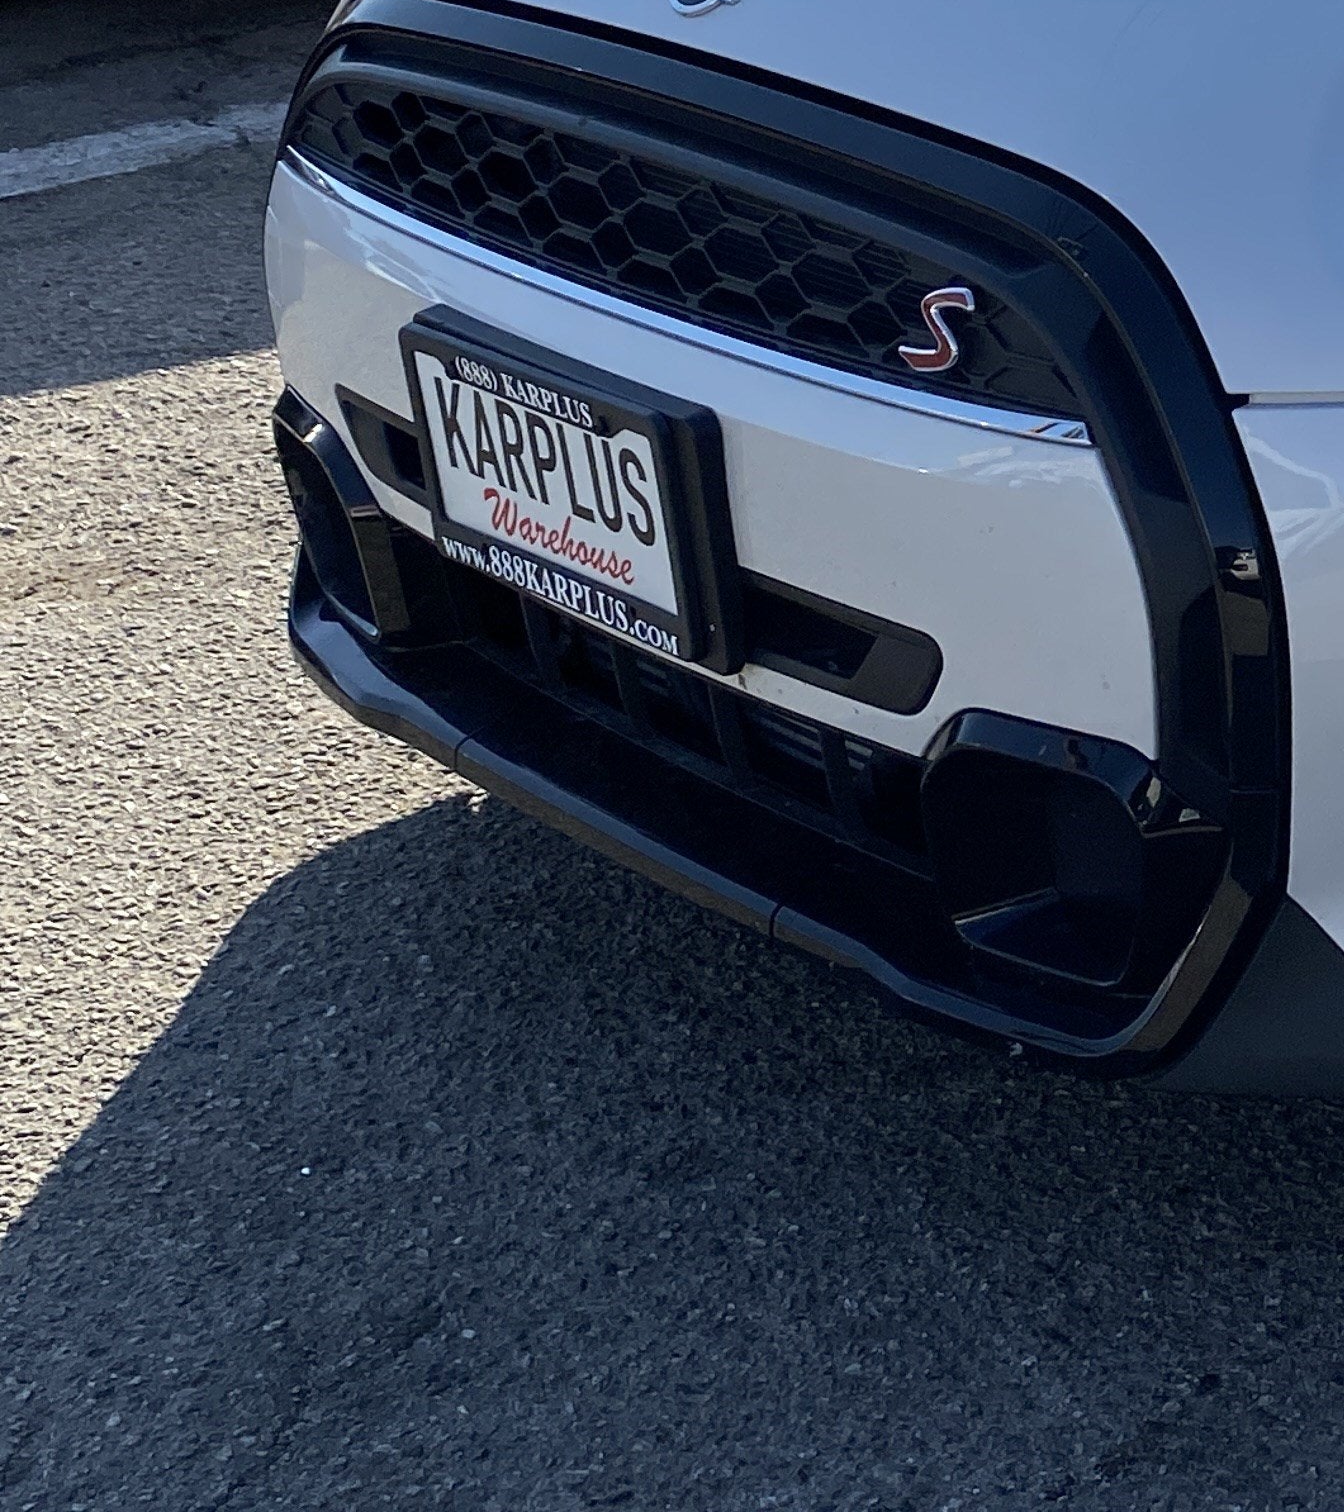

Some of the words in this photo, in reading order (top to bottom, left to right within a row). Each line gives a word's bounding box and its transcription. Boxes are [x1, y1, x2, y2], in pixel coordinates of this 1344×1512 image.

[898, 287, 975, 372] S
[455, 356, 498, 391] (888)
[500, 373, 593, 428] KARPLUS
[434, 376, 656, 546] KARPLUS
[484, 488, 635, 585] Warehouse
